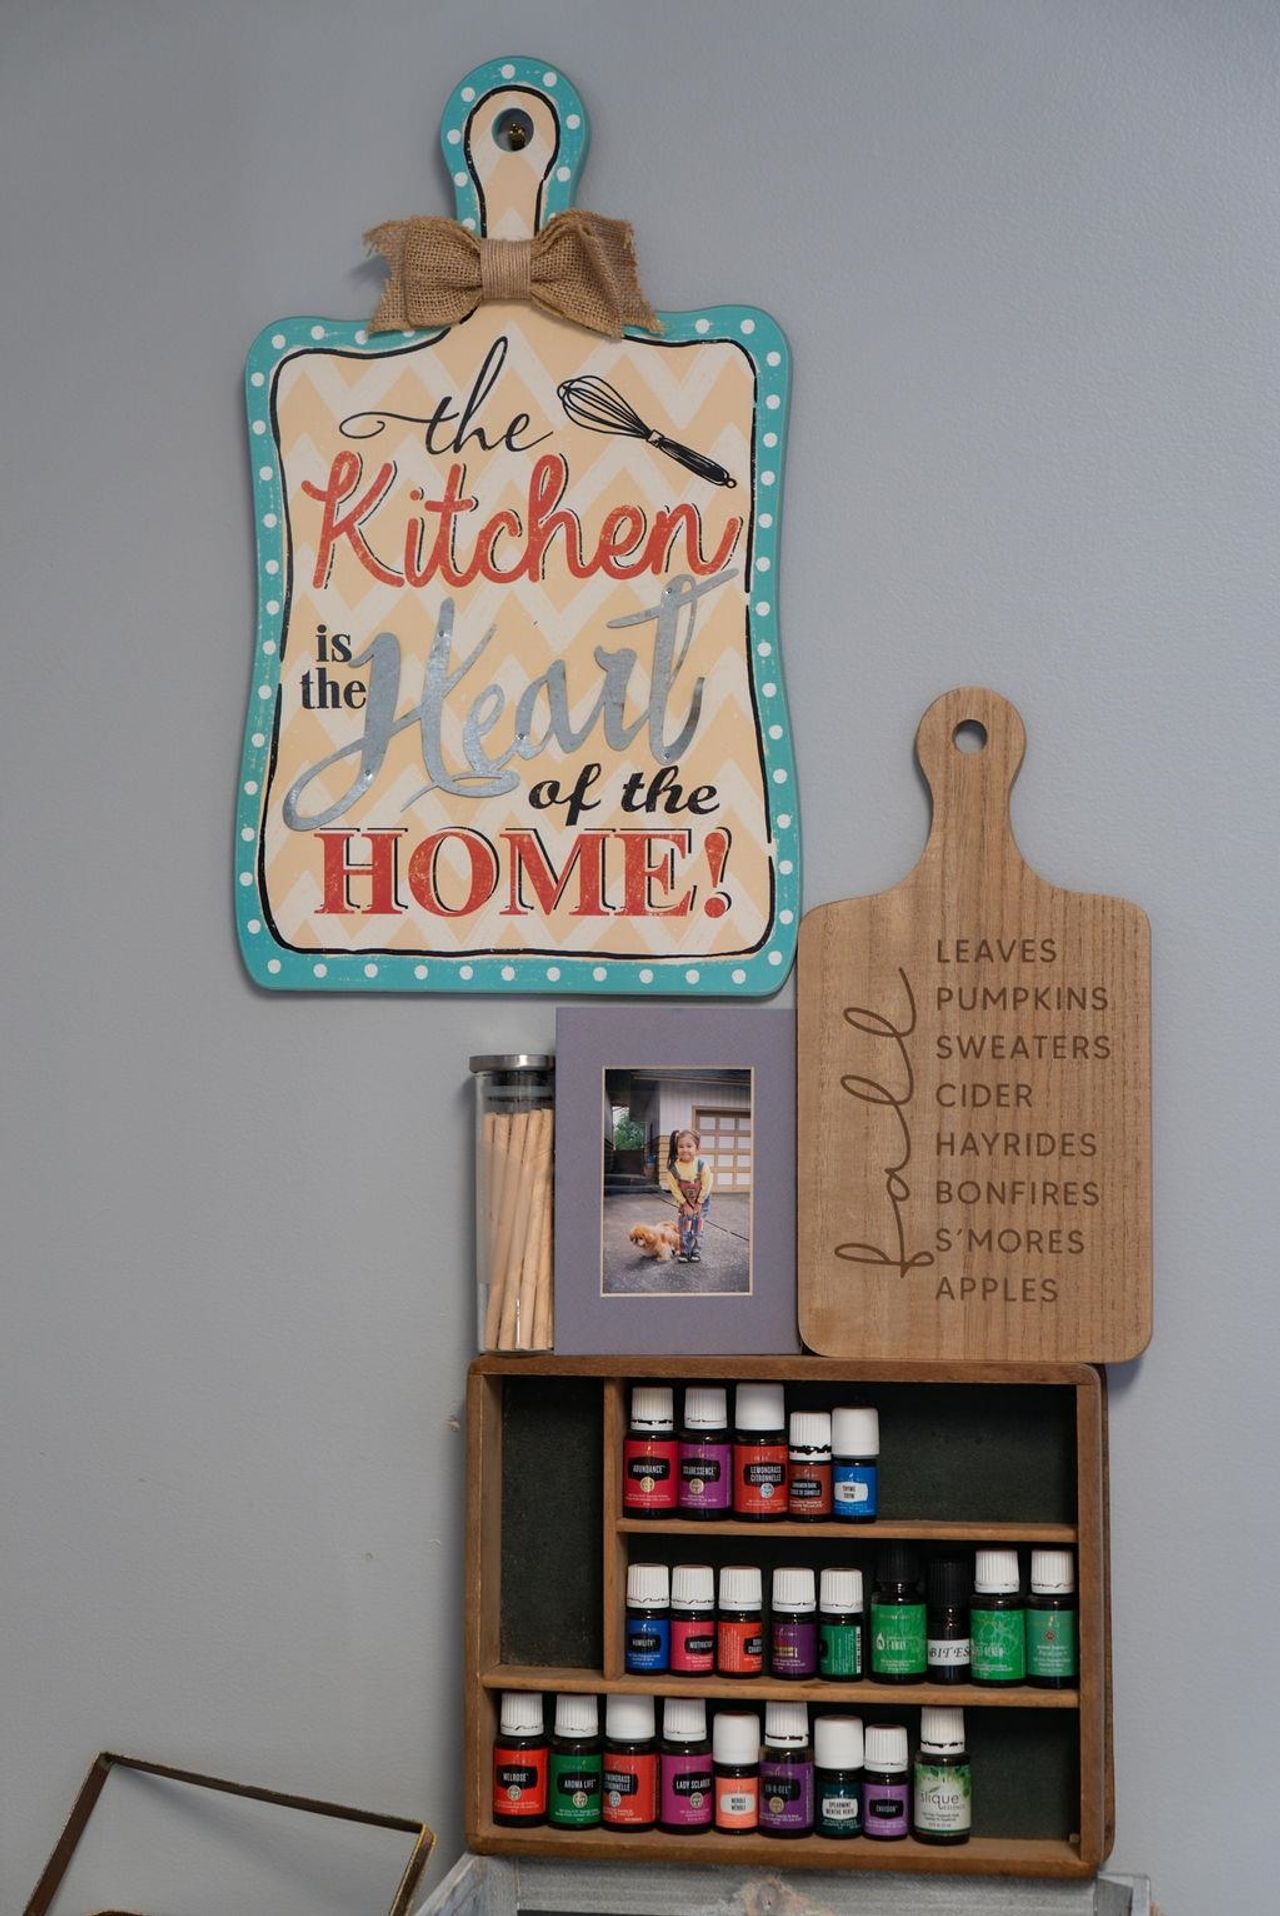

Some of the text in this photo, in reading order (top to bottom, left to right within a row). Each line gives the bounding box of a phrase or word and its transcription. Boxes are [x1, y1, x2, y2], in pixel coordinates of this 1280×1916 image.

[339, 336, 553, 456] the
[301, 451, 743, 589] Kitchen
[315, 625, 352, 663] is
[282, 568, 739, 832] Heart
[300, 668, 367, 710] the
[528, 763, 721, 826] of the
[313, 826, 732, 919] HOME!
[936, 938, 1058, 963] LEAVES
[936, 986, 1109, 1011] PUMPKINS
[936, 1035, 1112, 1060] SWEATERS
[936, 1083, 1033, 1108] CIDER
[834, 967, 935, 1278] fall
[936, 1132, 1098, 1157] HAYRIDES
[936, 1180, 1100, 1205] BONFIRES
[935, 1276, 1059, 1302] APPLES
[564, 1779, 582, 1789] AROMA
[676, 1780, 690, 1790] LADY
